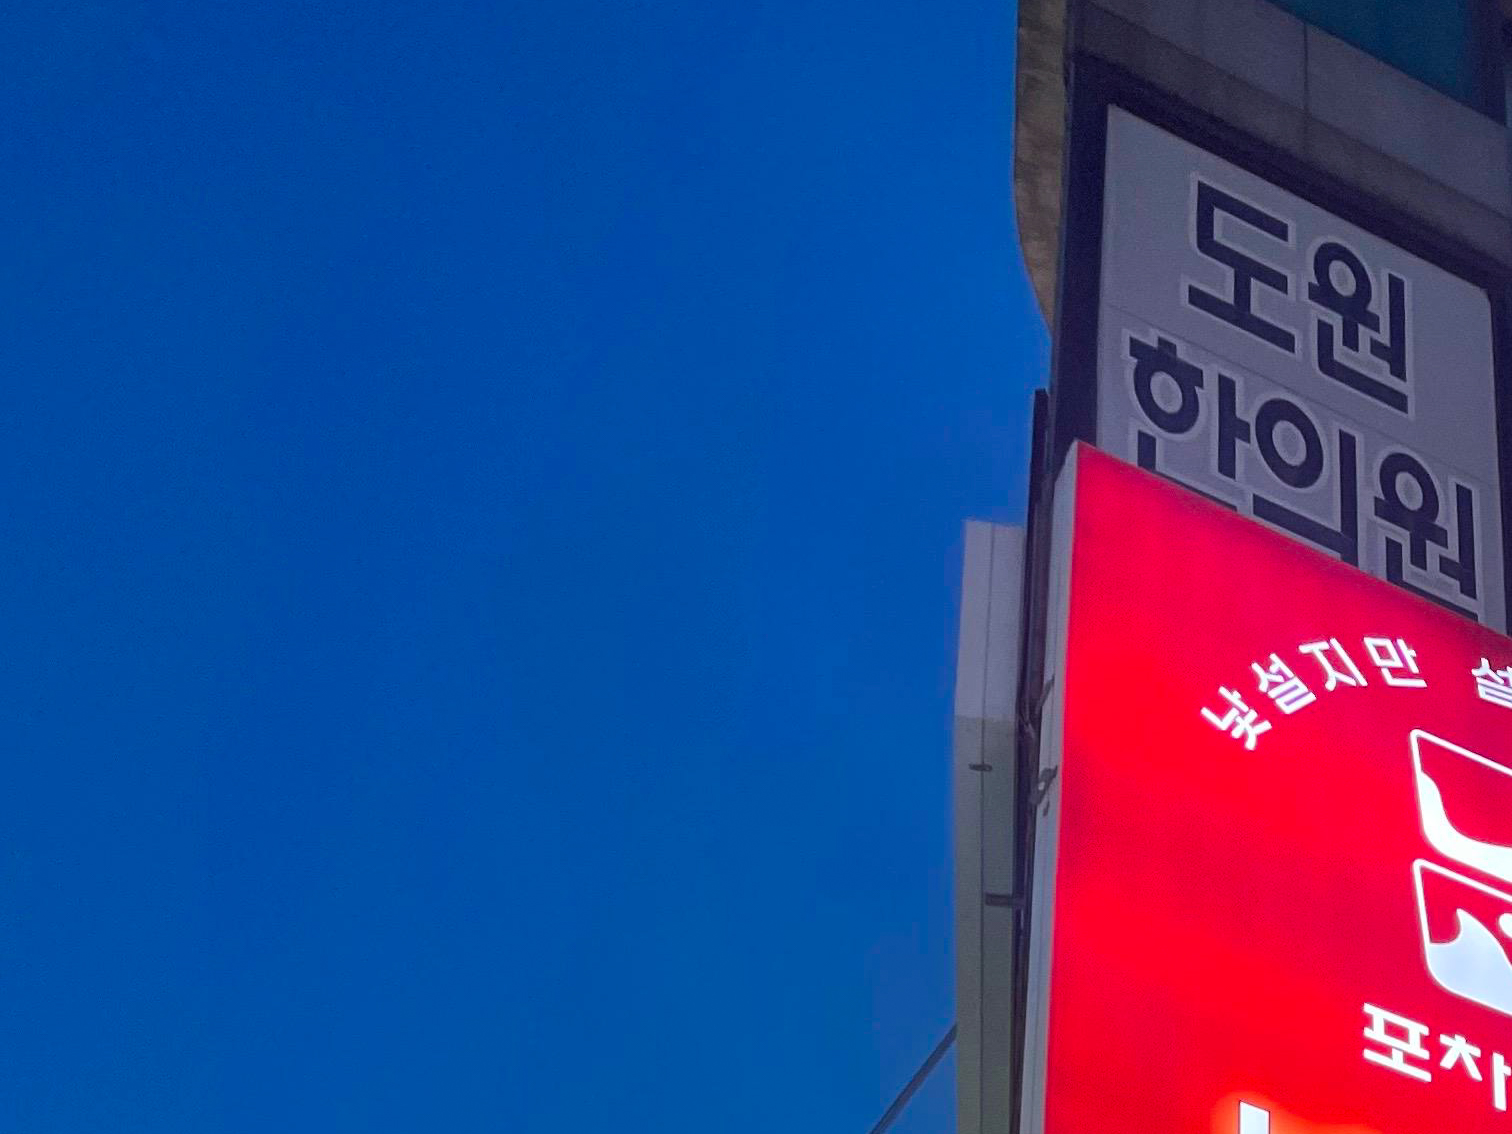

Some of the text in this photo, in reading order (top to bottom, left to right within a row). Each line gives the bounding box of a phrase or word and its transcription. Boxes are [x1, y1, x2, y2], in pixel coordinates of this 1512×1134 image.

[1187, 179, 1409, 414] 도원
[1129, 335, 1479, 620] 한의원
[1200, 636, 1428, 751] 낯설지만
[1363, 1001, 1512, 1112] 포차
